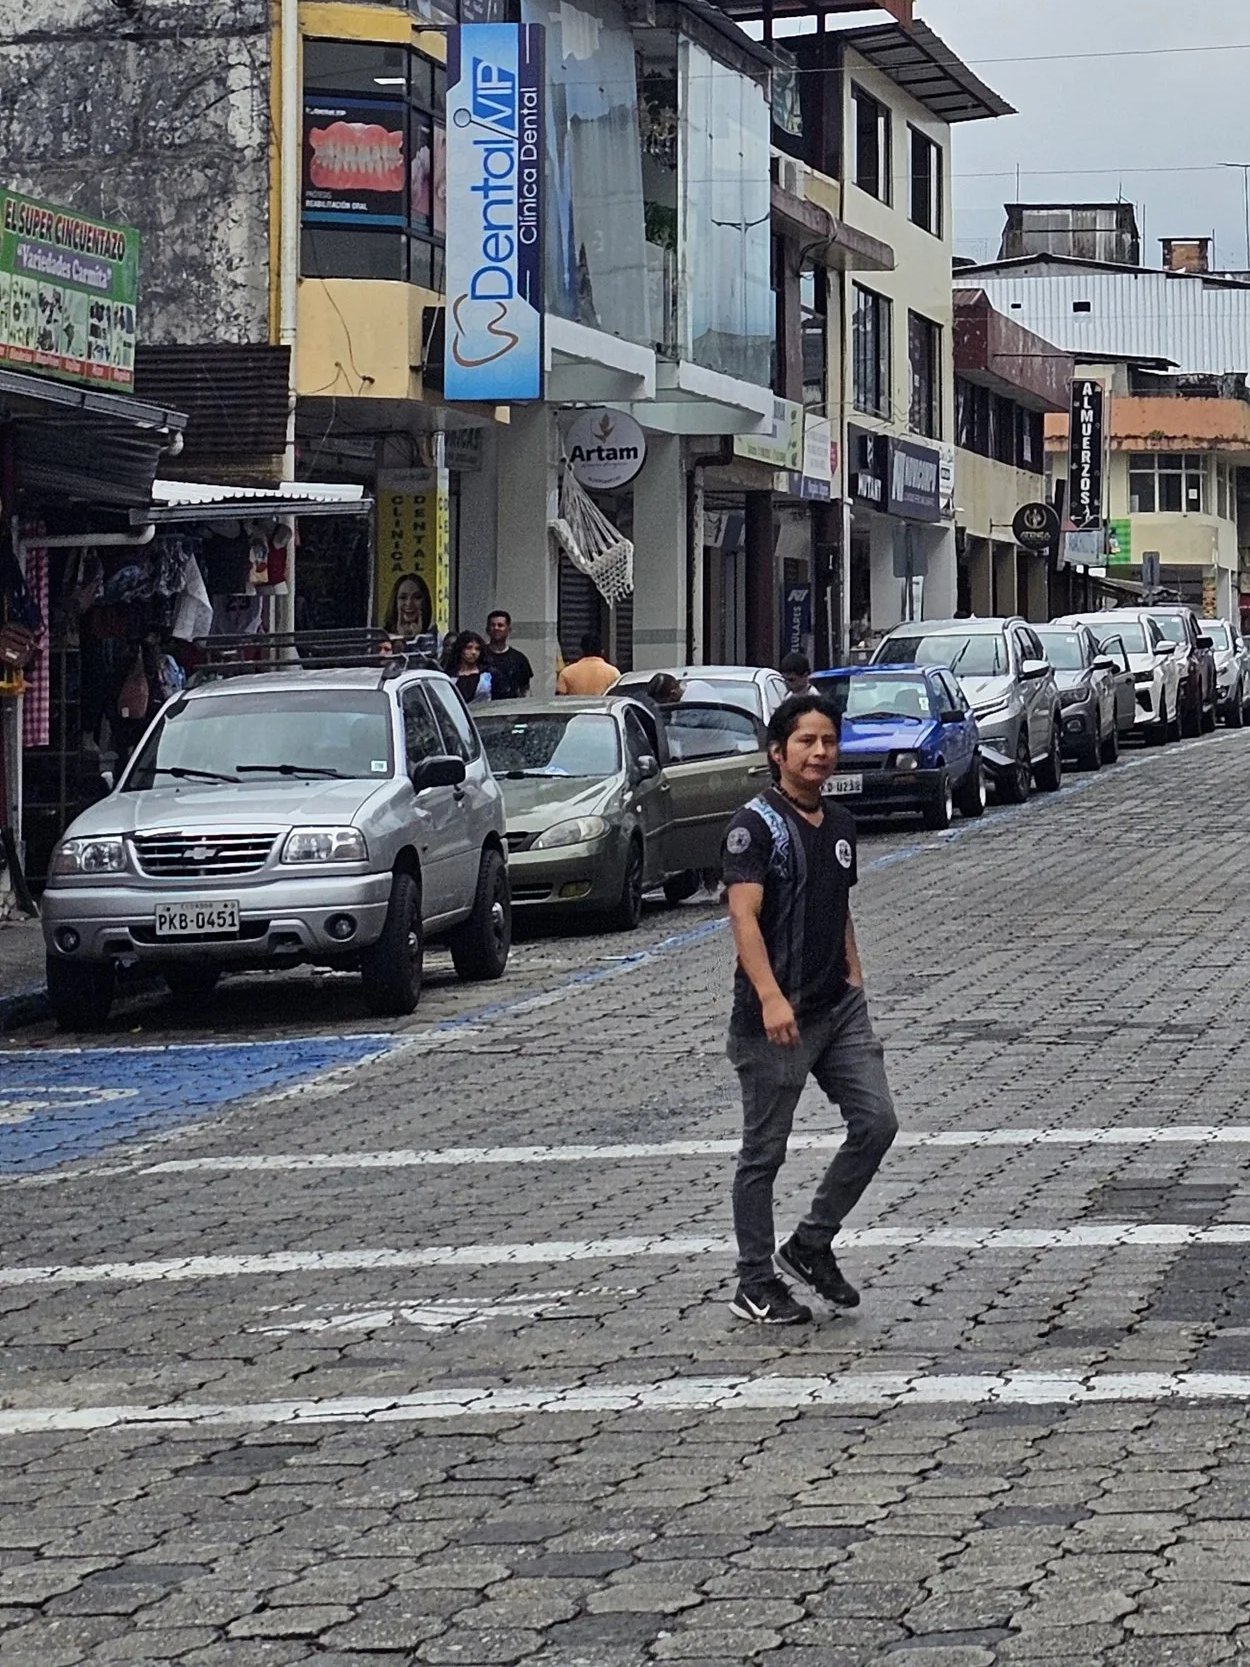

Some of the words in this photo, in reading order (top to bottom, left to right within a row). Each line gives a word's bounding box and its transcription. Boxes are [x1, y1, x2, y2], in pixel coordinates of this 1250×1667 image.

[475, 60, 515, 130] VIP
[519, 86, 538, 161] Dental
[5, 198, 17, 231] EL
[18, 203, 55, 243] SUPER
[55, 212, 126, 263] CINCUENTAZO
[470, 139, 515, 301] Dental
[569, 445, 638, 462] Artam
[1080, 381, 1094, 505] ALMUERZOS
[413, 495, 426, 572] DENTAL
[158, 910, 237, 931] PKB-0451
